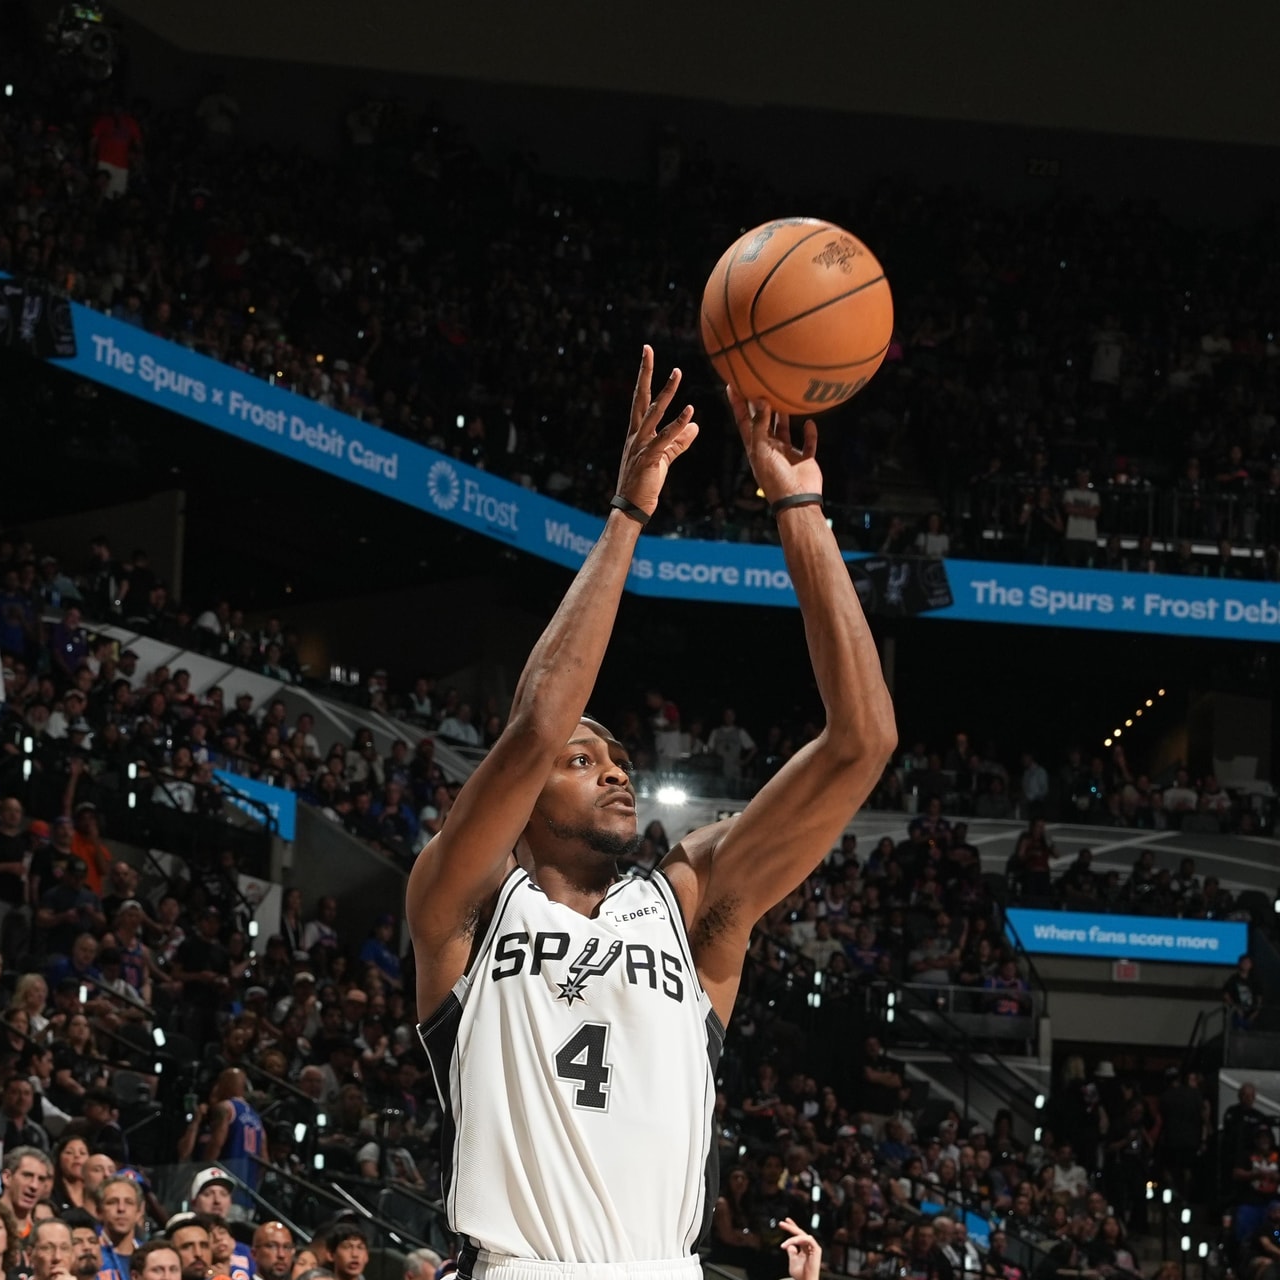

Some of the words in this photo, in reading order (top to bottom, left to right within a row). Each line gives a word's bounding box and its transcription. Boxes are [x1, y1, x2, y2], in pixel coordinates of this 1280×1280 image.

[91, 334, 135, 375] The
[138, 355, 207, 404] Spurs
[228, 390, 287, 435] Frost
[290, 414, 347, 459] Debit
[348, 439, 399, 480] Card
[463, 477, 519, 533] Frost
[544, 517, 597, 557] Wher
[658, 561, 739, 585] score
[745, 567, 793, 590] mo
[971, 580, 1024, 609] The
[1029, 584, 1115, 615] Spurs
[1144, 594, 1219, 622] Frost
[614, 904, 659, 925] LEDGER
[1033, 924, 1086, 942] Where
[1089, 925, 1128, 945] fans
[1129, 932, 1175, 948] score
[1176, 937, 1219, 951] more
[492, 931, 685, 1006] SPURS
[553, 1021, 613, 1113] 4
